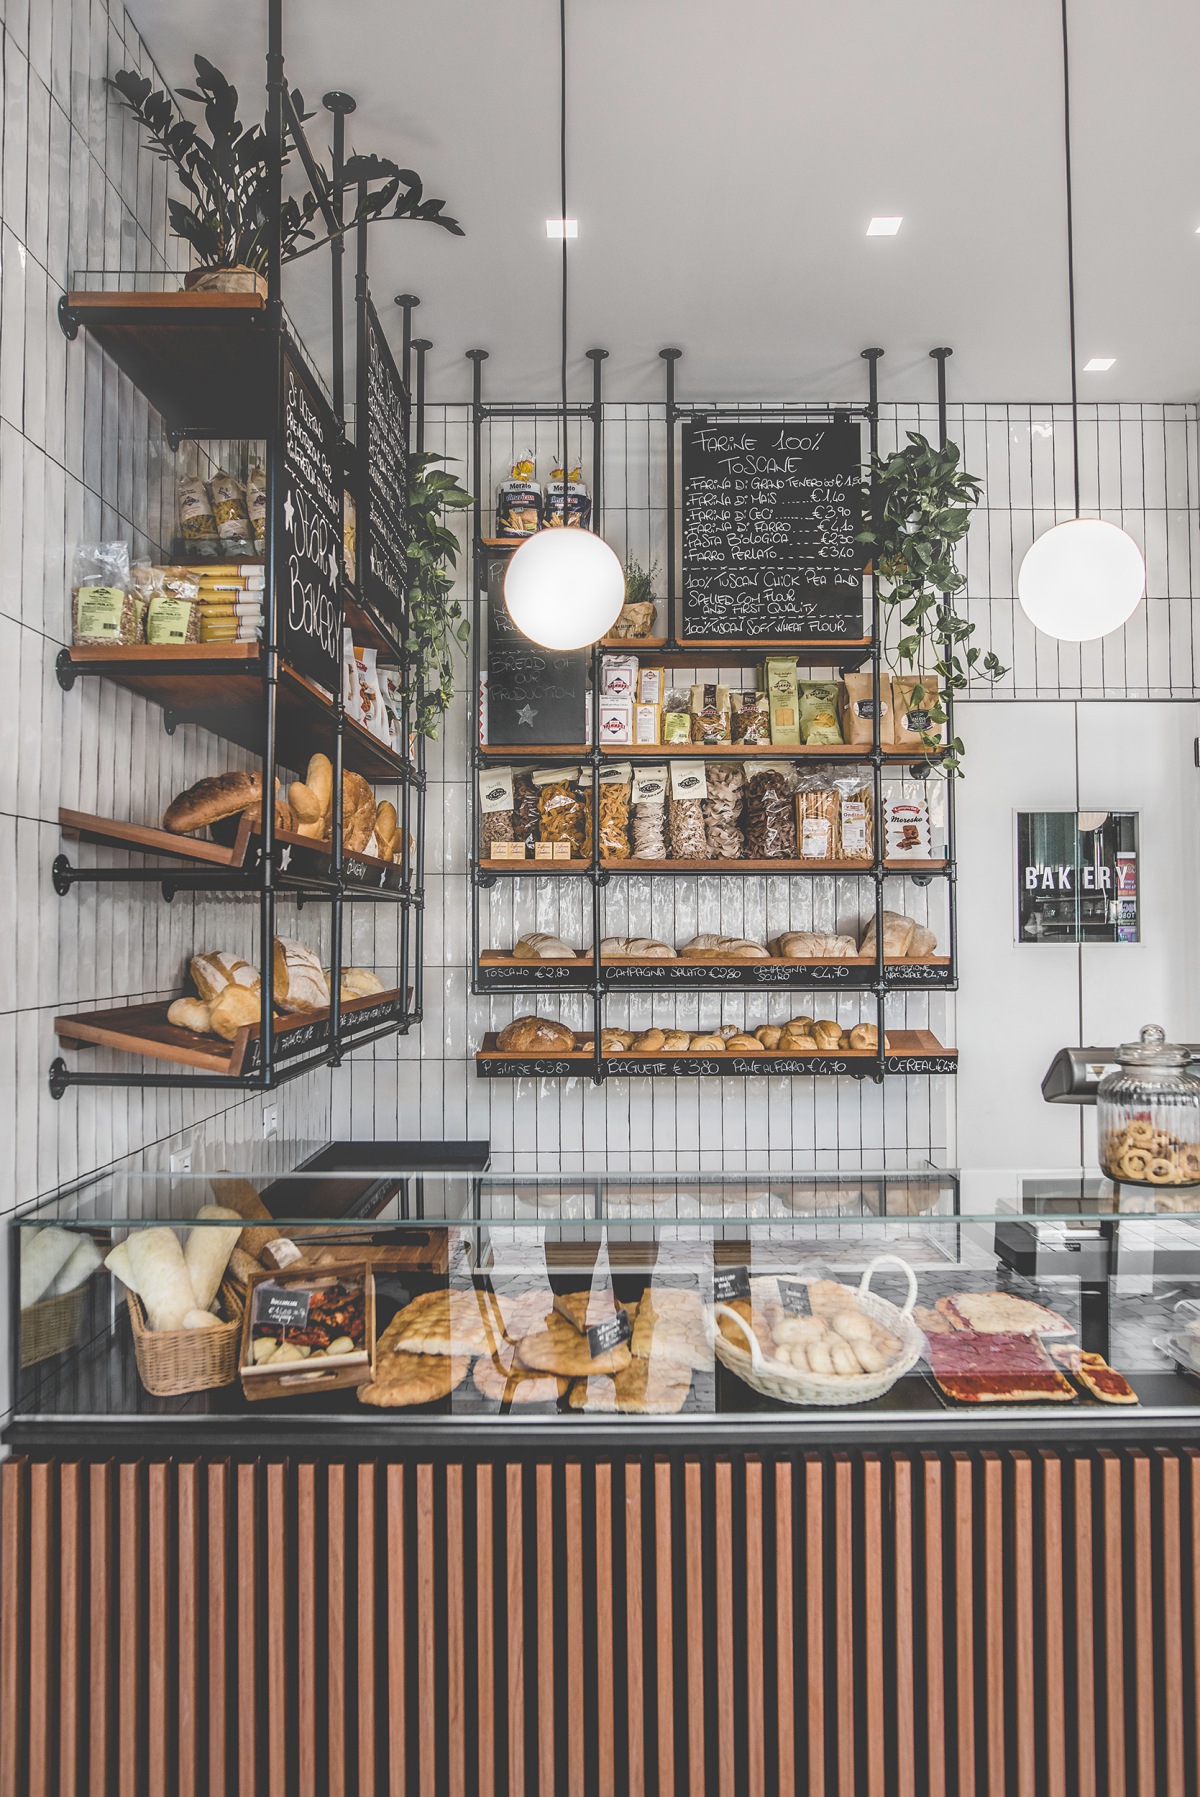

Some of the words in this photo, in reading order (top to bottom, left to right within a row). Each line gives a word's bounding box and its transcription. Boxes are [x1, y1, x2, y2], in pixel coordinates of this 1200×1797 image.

[772, 429, 825, 451] 100%
[717, 454, 803, 476] TOSCANE
[510, 482, 532, 490] Morato
[554, 484, 576, 492] Moato
[750, 476, 784, 490] GRANO
[754, 522, 792, 532] FARRO
[686, 533, 722, 548] PASTA
[688, 548, 725, 562] FARRO
[730, 546, 778, 560] PERLATO
[684, 575, 712, 590] 100%
[714, 572, 760, 588] TUSCAN
[804, 570, 827, 585] PEA
[834, 574, 860, 587] AND
[763, 588, 796, 602] FLOUR
[702, 604, 726, 614] AND
[732, 602, 765, 614] FIRST
[746, 620, 776, 636] SOFT
[775, 620, 805, 633] WHEAT
[808, 620, 847, 633] FLOUR
[490, 656, 546, 674] BREAD
[554, 657, 576, 670] OF
[514, 670, 540, 684] OUR
[489, 684, 576, 700] PRODUCTION
[1025, 866, 1128, 890] BAKERY
[484, 967, 530, 978] TOSCANO
[606, 966, 666, 978] CAMPAGNA
[670, 966, 707, 978] SALATO
[756, 973, 790, 982] SCURO
[606, 1058, 668, 1076] BAGUETTE
[732, 1058, 760, 1074] PANE
